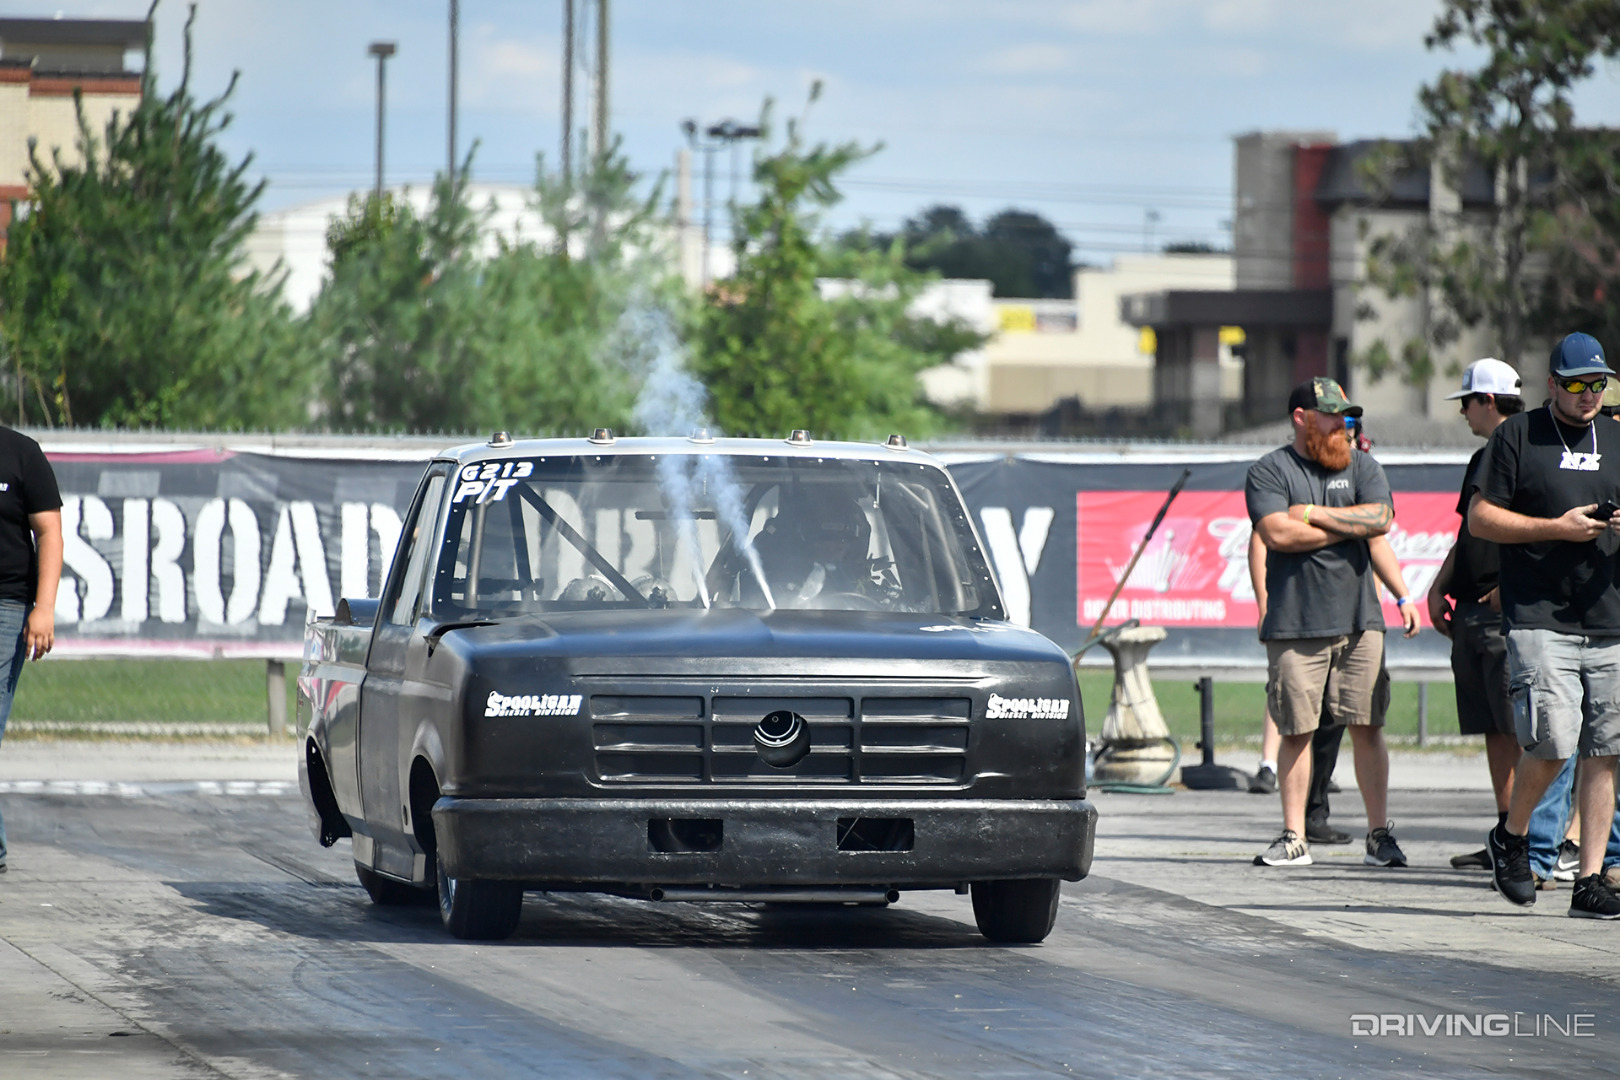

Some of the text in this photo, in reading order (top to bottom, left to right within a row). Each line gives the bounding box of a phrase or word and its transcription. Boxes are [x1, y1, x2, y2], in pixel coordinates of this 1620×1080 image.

[461, 462, 534, 481] G213
[452, 478, 519, 504] P/T
[1131, 599, 1226, 621] DISTRIBUTING
[484, 689, 583, 717] SPOOLIGAN
